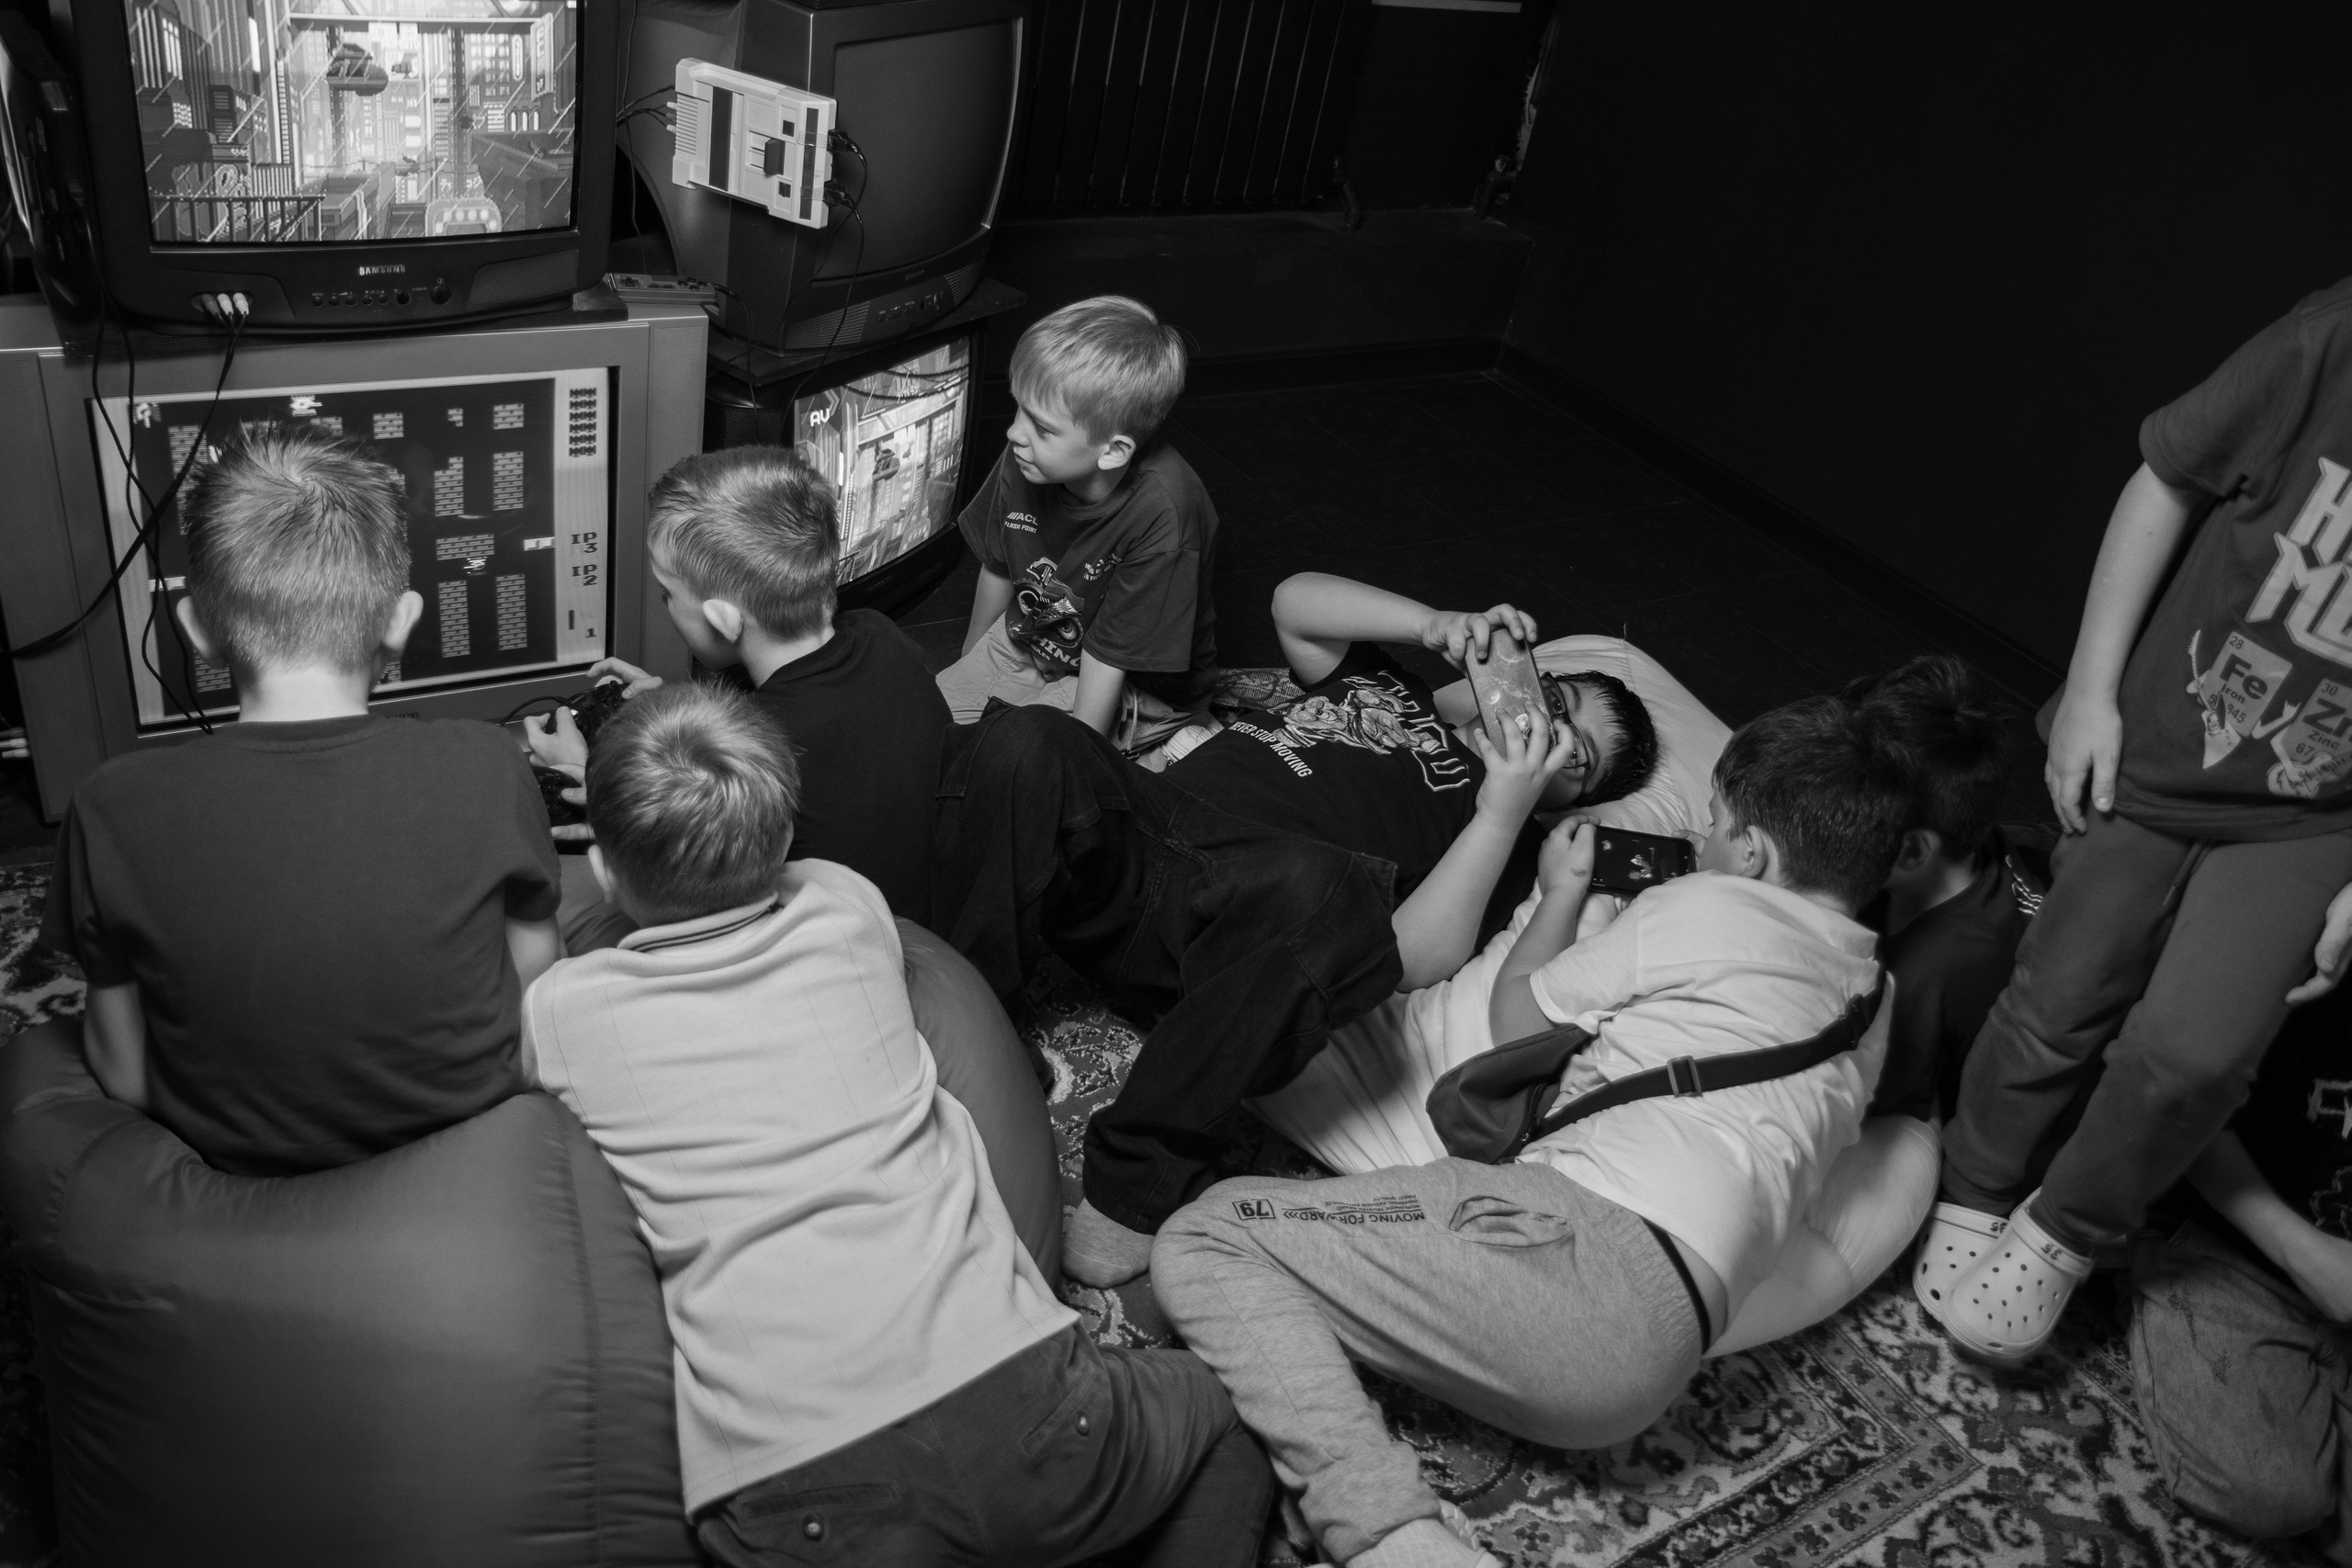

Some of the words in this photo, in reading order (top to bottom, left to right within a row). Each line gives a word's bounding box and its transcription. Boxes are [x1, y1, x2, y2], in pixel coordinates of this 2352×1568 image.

[359, 264, 405, 276] SAMSUNG
[809, 408, 830, 427] AV
[1021, 525, 1037, 534] POINT
[583, 542, 597, 553] 3
[583, 575, 597, 586] 2
[2228, 636, 2245, 650] 28
[2219, 653, 2267, 700] Fe
[2221, 683, 2246, 704] Iron
[2322, 682, 2338, 696] 30
[2307, 729, 2340, 750] Zinc
[1228, 721, 1258, 734] NEVER
[1250, 728, 1278, 742] STOP
[1270, 741, 1313, 777] MOVING
[2296, 742, 2315, 756] 67
[1238, 1200, 1270, 1217] 79
[1368, 1212, 1426, 1224] MOVING
